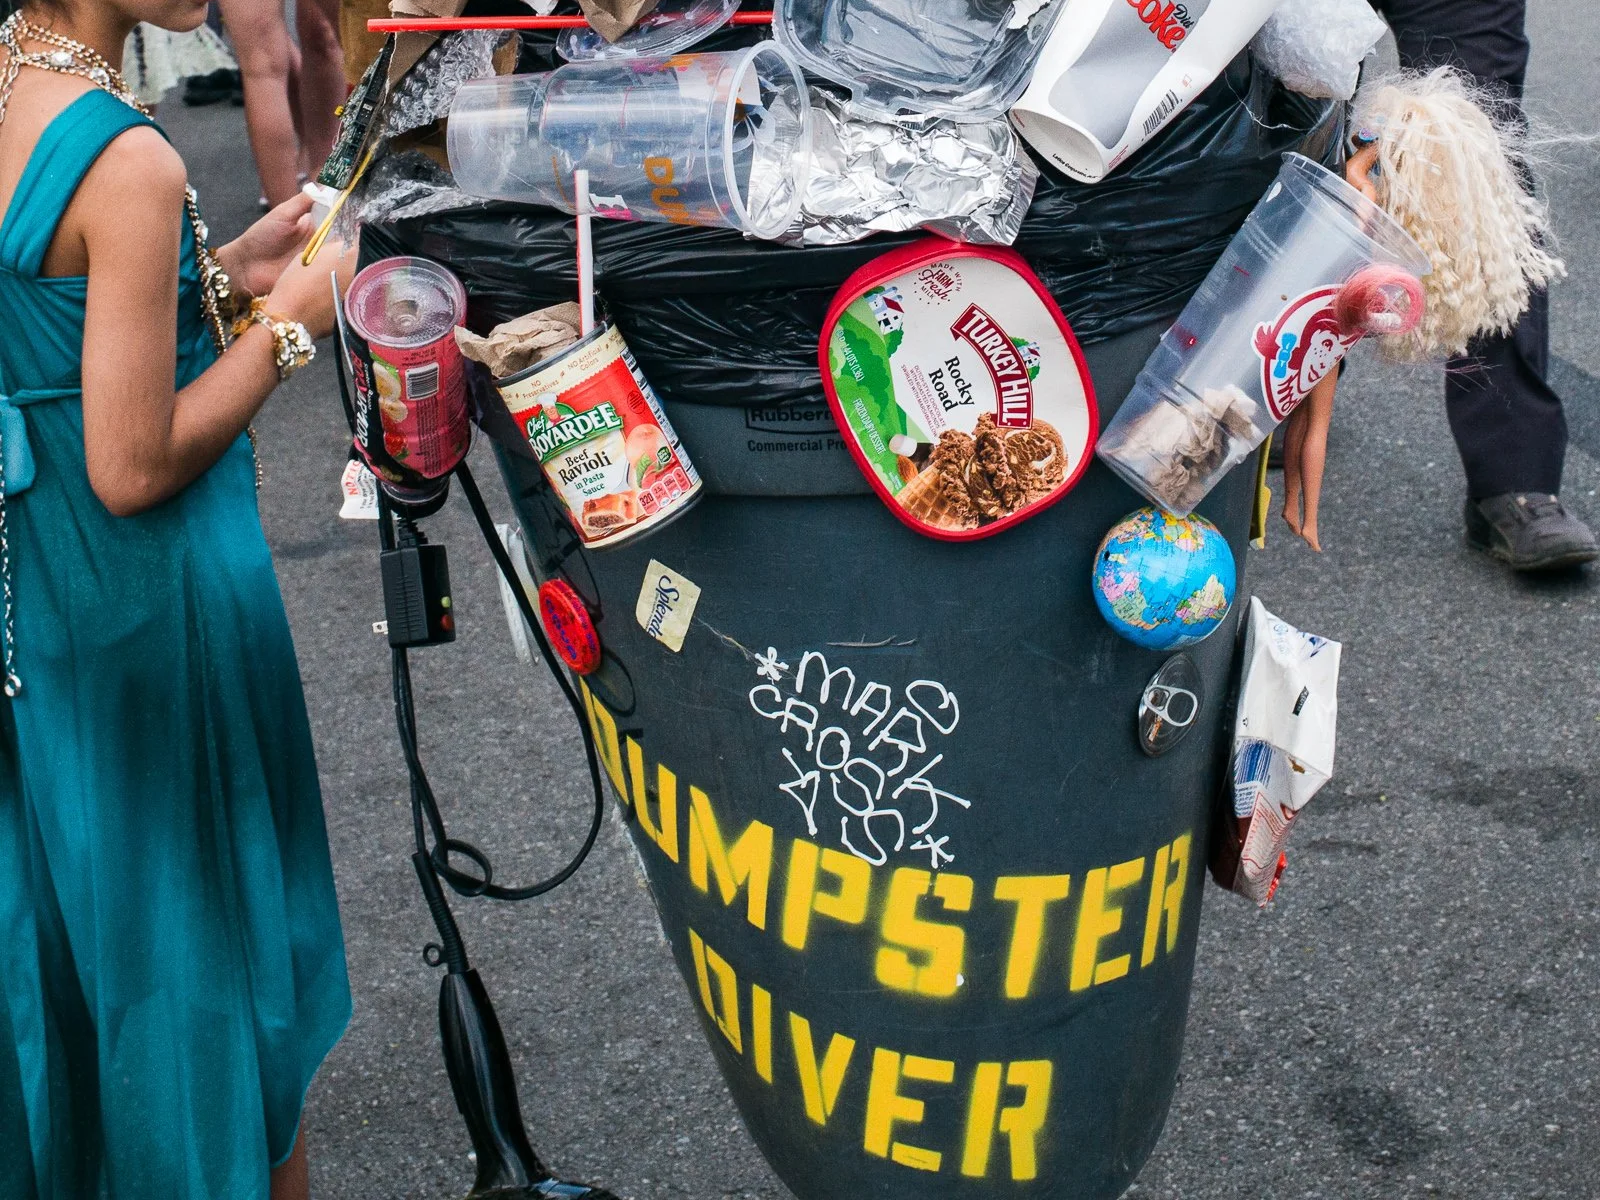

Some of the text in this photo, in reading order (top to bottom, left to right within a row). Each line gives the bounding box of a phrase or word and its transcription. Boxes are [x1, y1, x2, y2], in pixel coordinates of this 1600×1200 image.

[1173, 3, 1194, 29] Diet
[919, 269, 952, 300] Fresh
[935, 269, 954, 288] FARM
[921, 286, 934, 299] MILK
[961, 311, 1022, 378] TURKEY
[568, 361, 577, 369] NO
[580, 357, 599, 371] Colors
[845, 352, 857, 366] QTS
[522, 380, 559, 399] Preservatives
[531, 380, 541, 388] NO
[915, 381, 929, 403] ROASTED
[928, 368, 958, 412] Road
[944, 356, 975, 406] Rocky
[928, 396, 946, 427] CHOCOLATE
[527, 415, 545, 437] Chef
[529, 404, 621, 461] BOYARDEE
[852, 397, 886, 454] FROZEN DAIRY DESSERT
[748, 440, 823, 452] Commercial
[559, 451, 612, 485] Ravioli
[565, 449, 589, 467] Beef
[574, 472, 605, 490] in Pasta
[584, 483, 605, 496] Sauce
[640, 493, 654, 506] 320
[579, 674, 1192, 1000] DUMPSTER
[689, 928, 1053, 1181] DIVER
